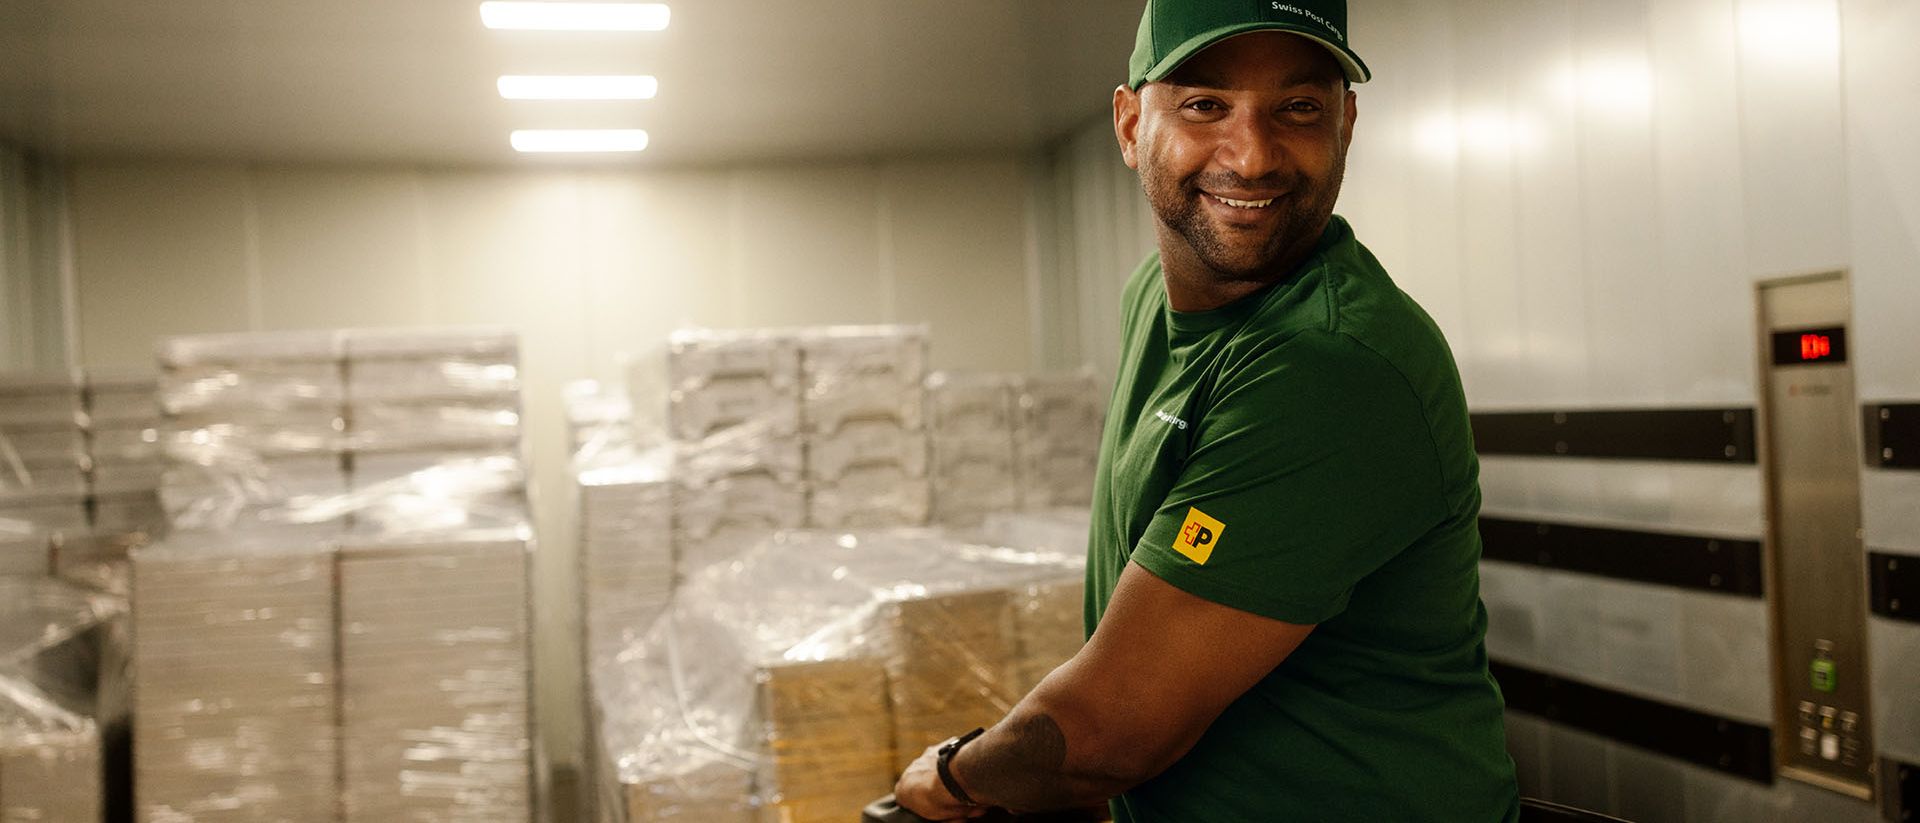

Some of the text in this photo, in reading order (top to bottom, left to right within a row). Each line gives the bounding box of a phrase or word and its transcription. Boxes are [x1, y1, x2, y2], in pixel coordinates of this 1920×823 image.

[1271, 1, 1303, 15] Swiss
[1305, 9, 1325, 25] Post
[1192, 526, 1213, 548] P
